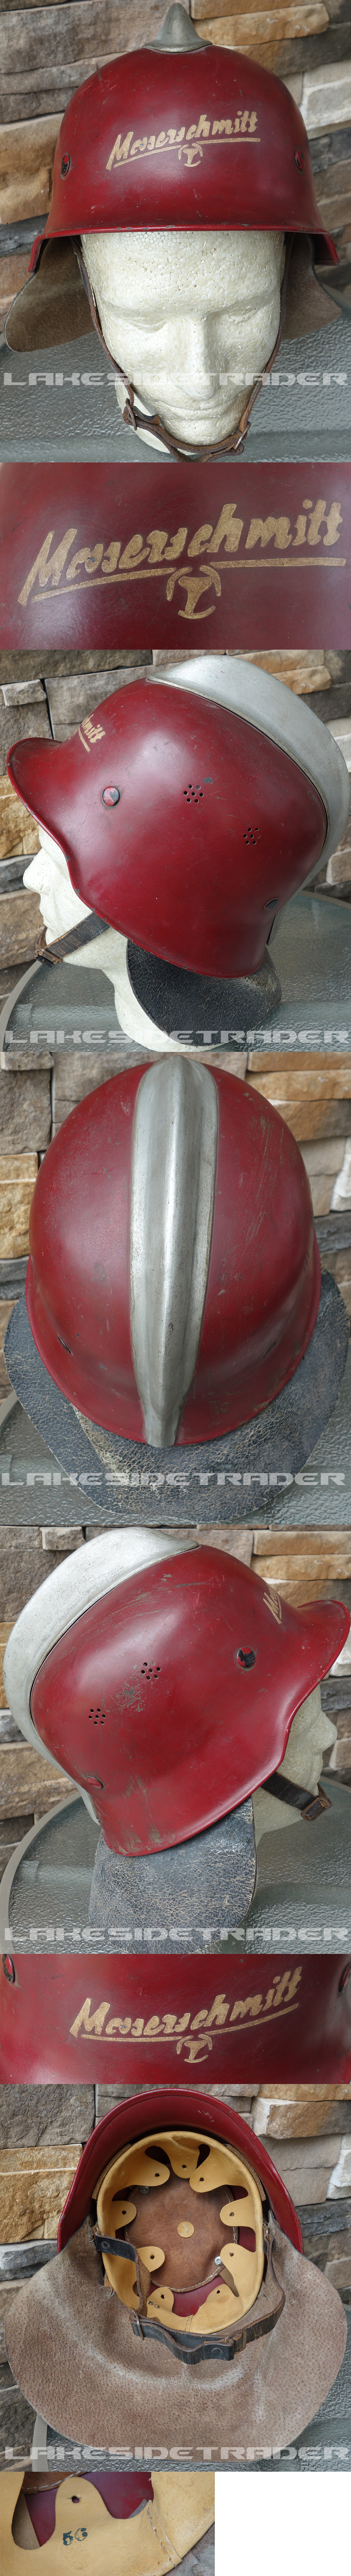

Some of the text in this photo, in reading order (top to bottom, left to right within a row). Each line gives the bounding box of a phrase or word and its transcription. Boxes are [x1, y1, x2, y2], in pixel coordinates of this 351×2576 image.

[106, 110, 259, 170] Messerschmitt
[18, 499, 343, 607] Messerschmitt
[69, 1966, 302, 2037] Messerschmitt
[62, 2528, 88, 2546] 56
